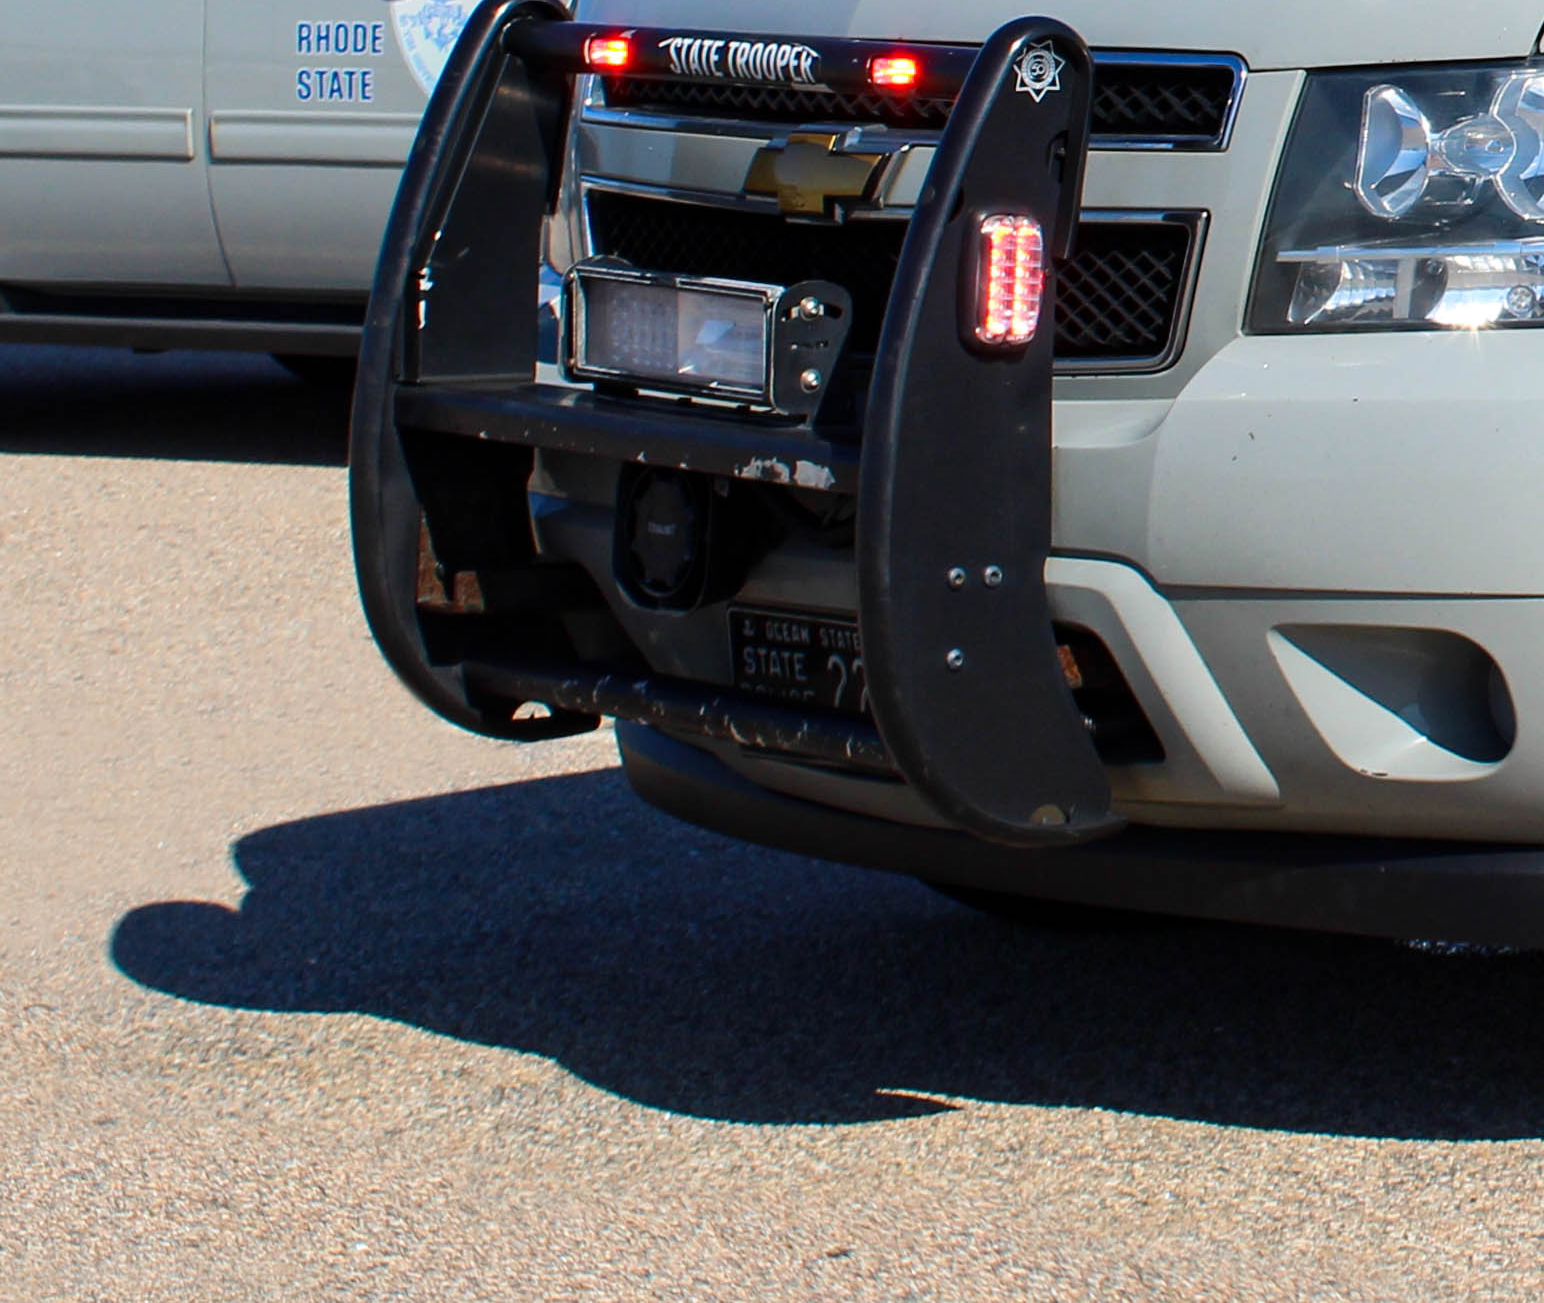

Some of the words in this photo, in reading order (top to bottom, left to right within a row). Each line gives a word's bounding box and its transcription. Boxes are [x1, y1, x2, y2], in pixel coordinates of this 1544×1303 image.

[296, 22, 384, 54] RHODE
[659, 37, 726, 78] STATE
[727, 41, 821, 84] TROOPER
[296, 70, 373, 101] STATE
[765, 620, 810, 644] OCEAN
[743, 645, 808, 682] STATE
